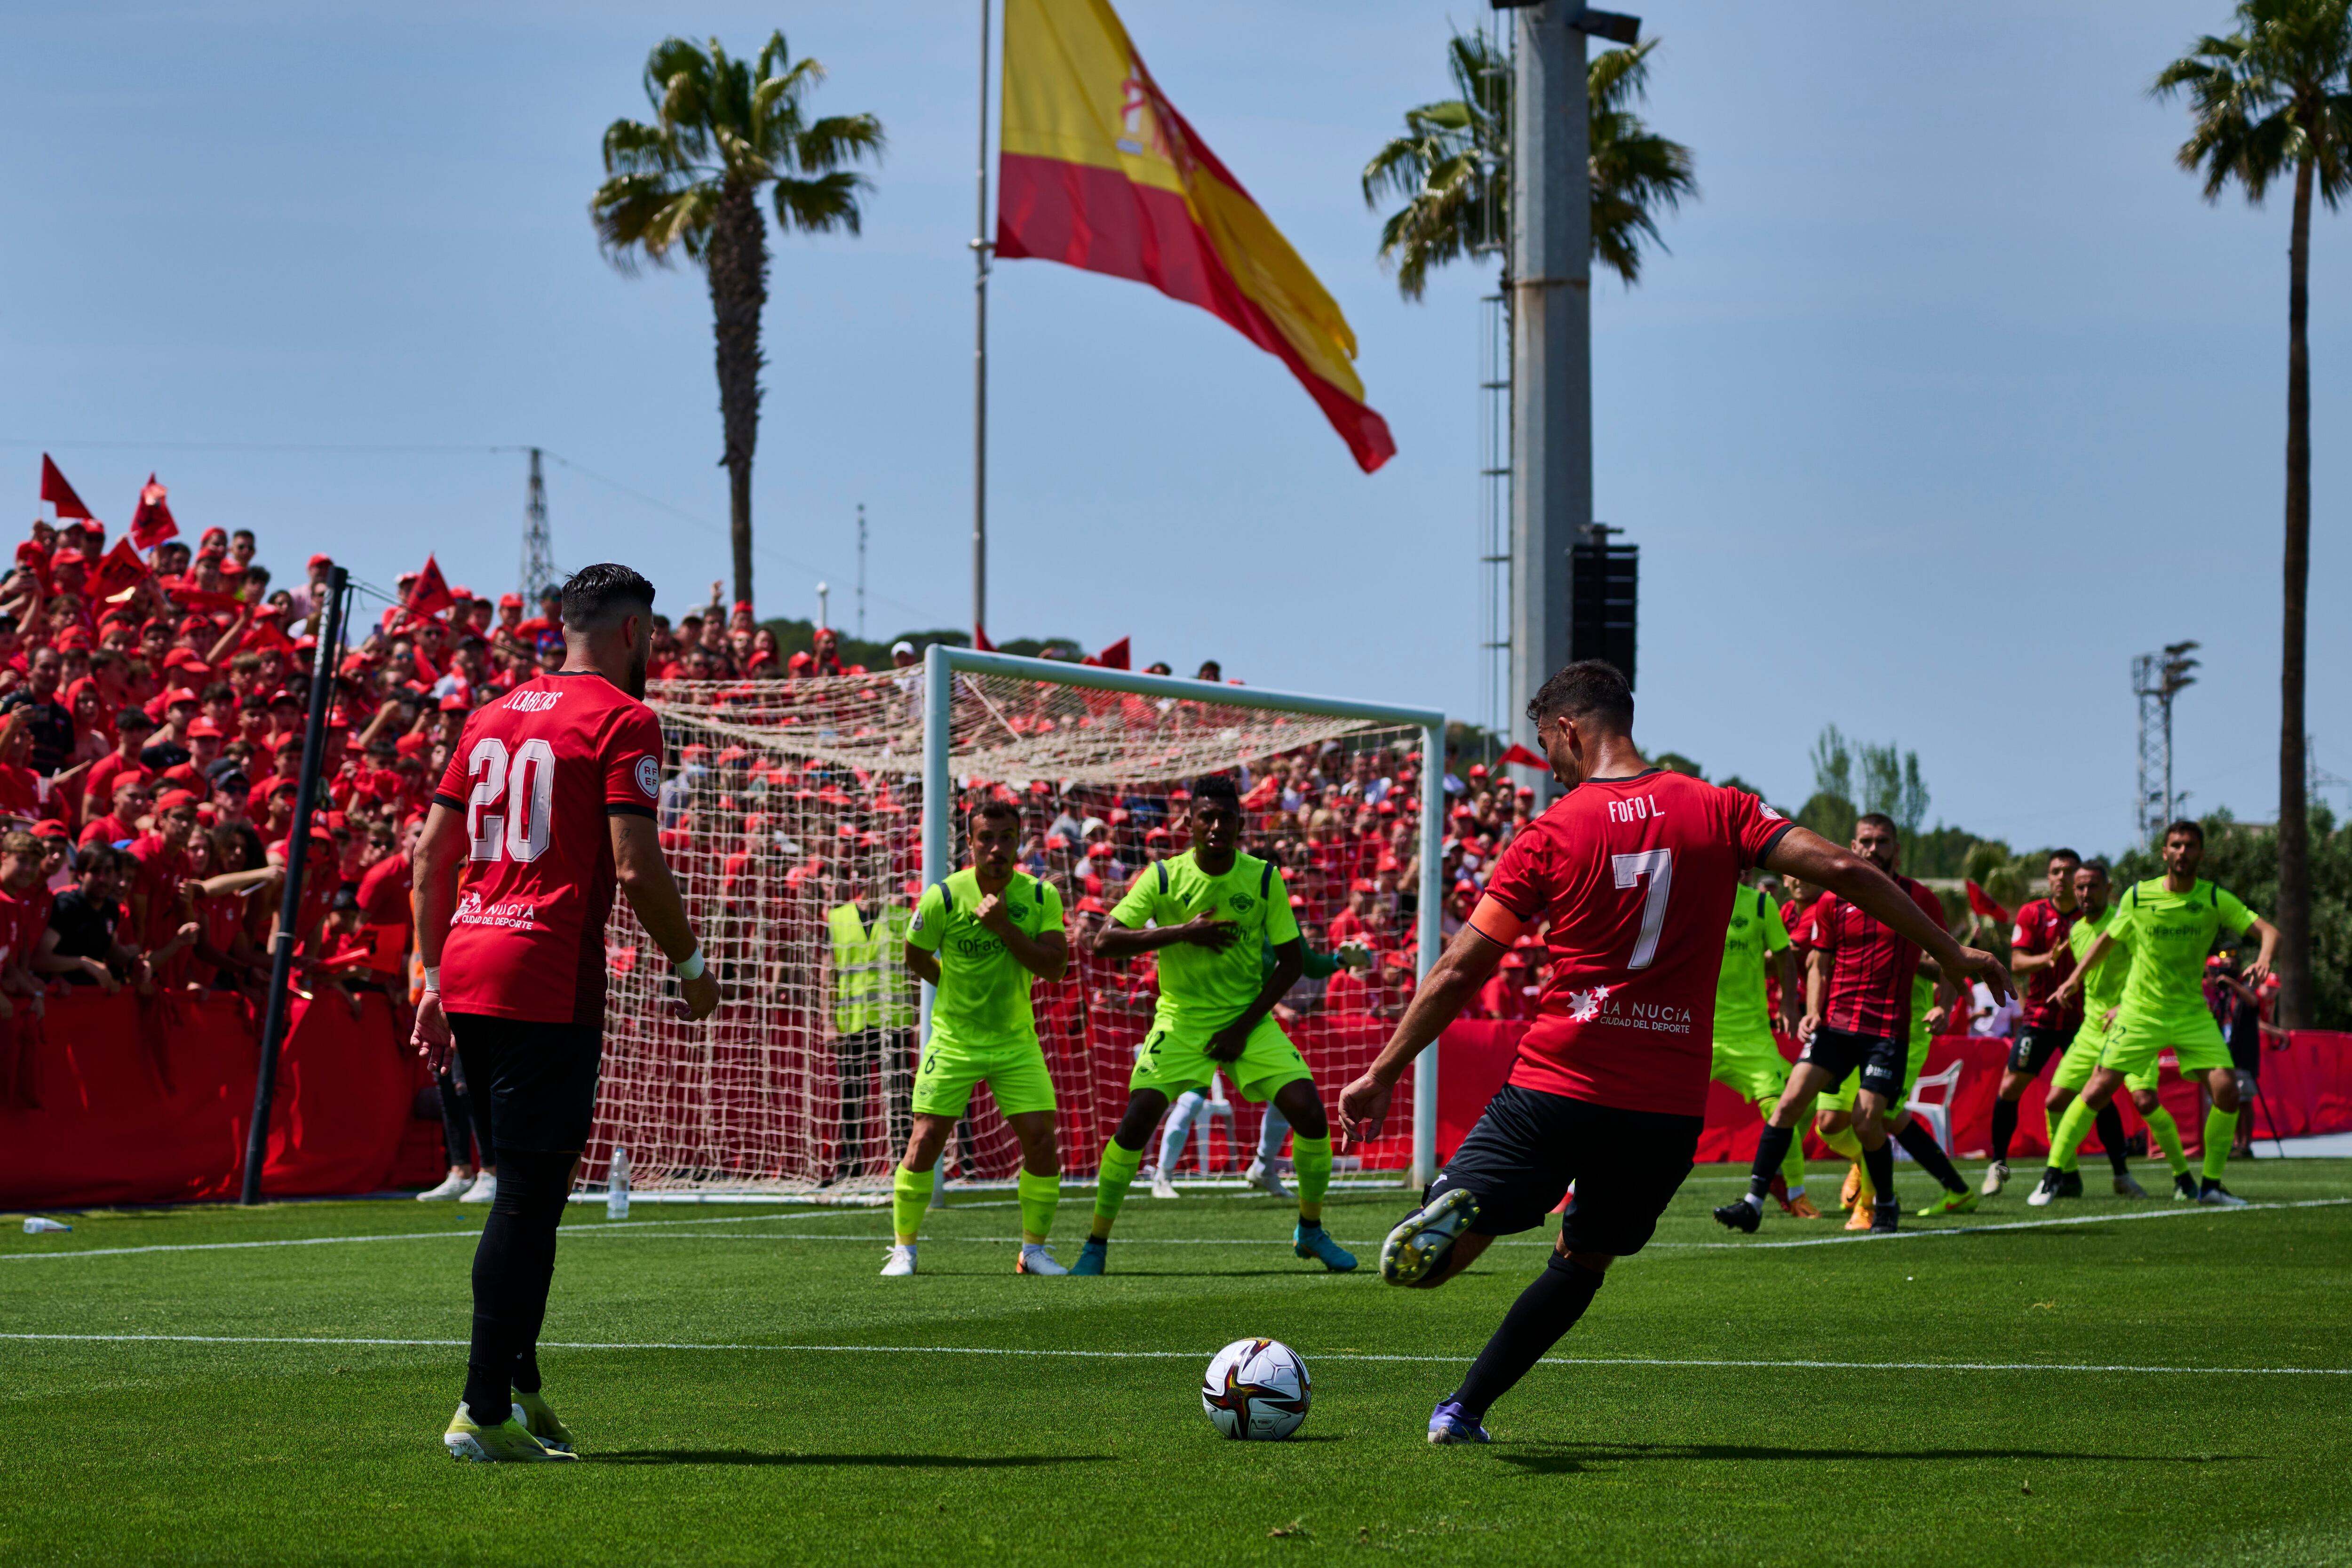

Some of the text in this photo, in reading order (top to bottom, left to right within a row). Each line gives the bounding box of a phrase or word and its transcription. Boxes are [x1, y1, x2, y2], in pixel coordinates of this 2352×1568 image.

[644, 766, 657, 775] RF
[645, 777, 657, 787] EF
[467, 737, 556, 862] 20
[1608, 795, 1665, 822] FOFO L.
[1611, 848, 1672, 970] 7
[462, 915, 482, 923] CIUDAD
[495, 917, 533, 930] DEPORTE
[1603, 1000, 1620, 1015] LA
[1600, 1016, 1690, 1034] CIUDAD DEL DEPORTE
[925, 1049, 940, 1074] 6
